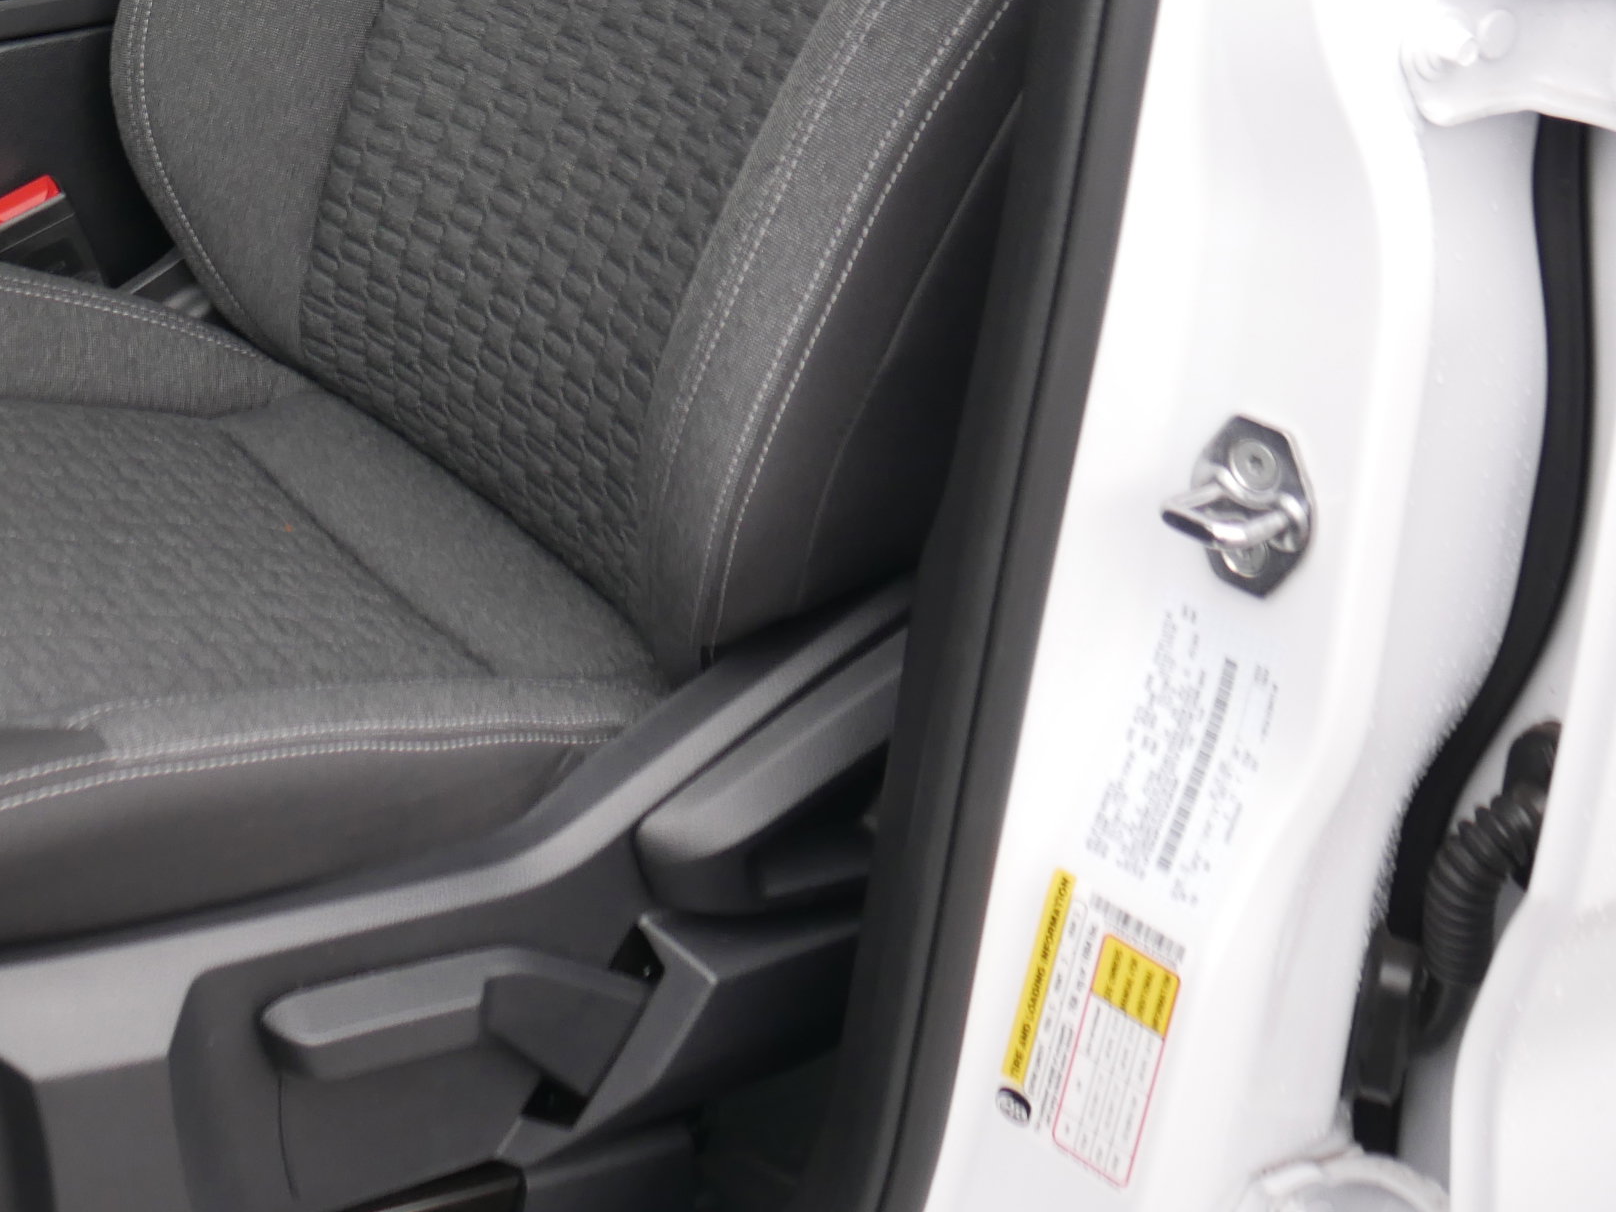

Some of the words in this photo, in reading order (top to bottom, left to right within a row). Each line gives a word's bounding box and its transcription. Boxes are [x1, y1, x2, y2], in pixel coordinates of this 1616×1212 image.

[1010, 1048, 1025, 1079] TIRE
[1018, 1021, 1031, 1049] AND
[1026, 965, 1047, 1019] LOADING
[1041, 875, 1070, 962] INFORMATION
